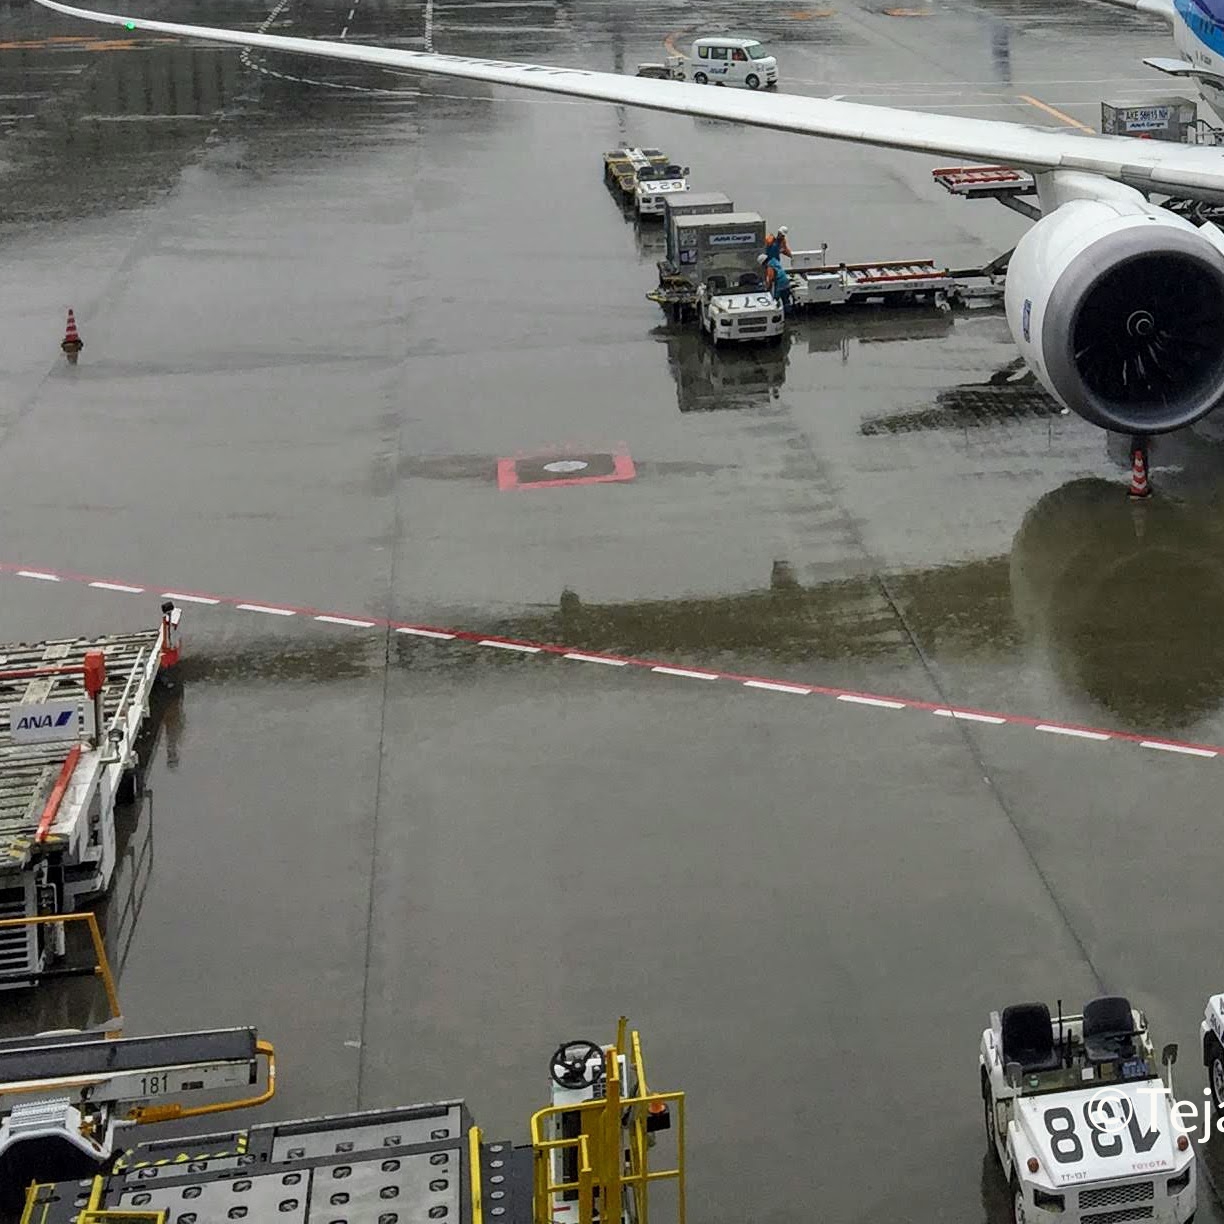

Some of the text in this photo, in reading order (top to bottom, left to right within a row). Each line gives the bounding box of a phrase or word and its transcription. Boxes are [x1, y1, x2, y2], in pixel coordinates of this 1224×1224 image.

[16, 714, 53, 730] ANA
[140, 1074, 169, 1096] 181
[1043, 1096, 1162, 1164] 138
[1131, 1159, 1168, 1171] TOYOTA
